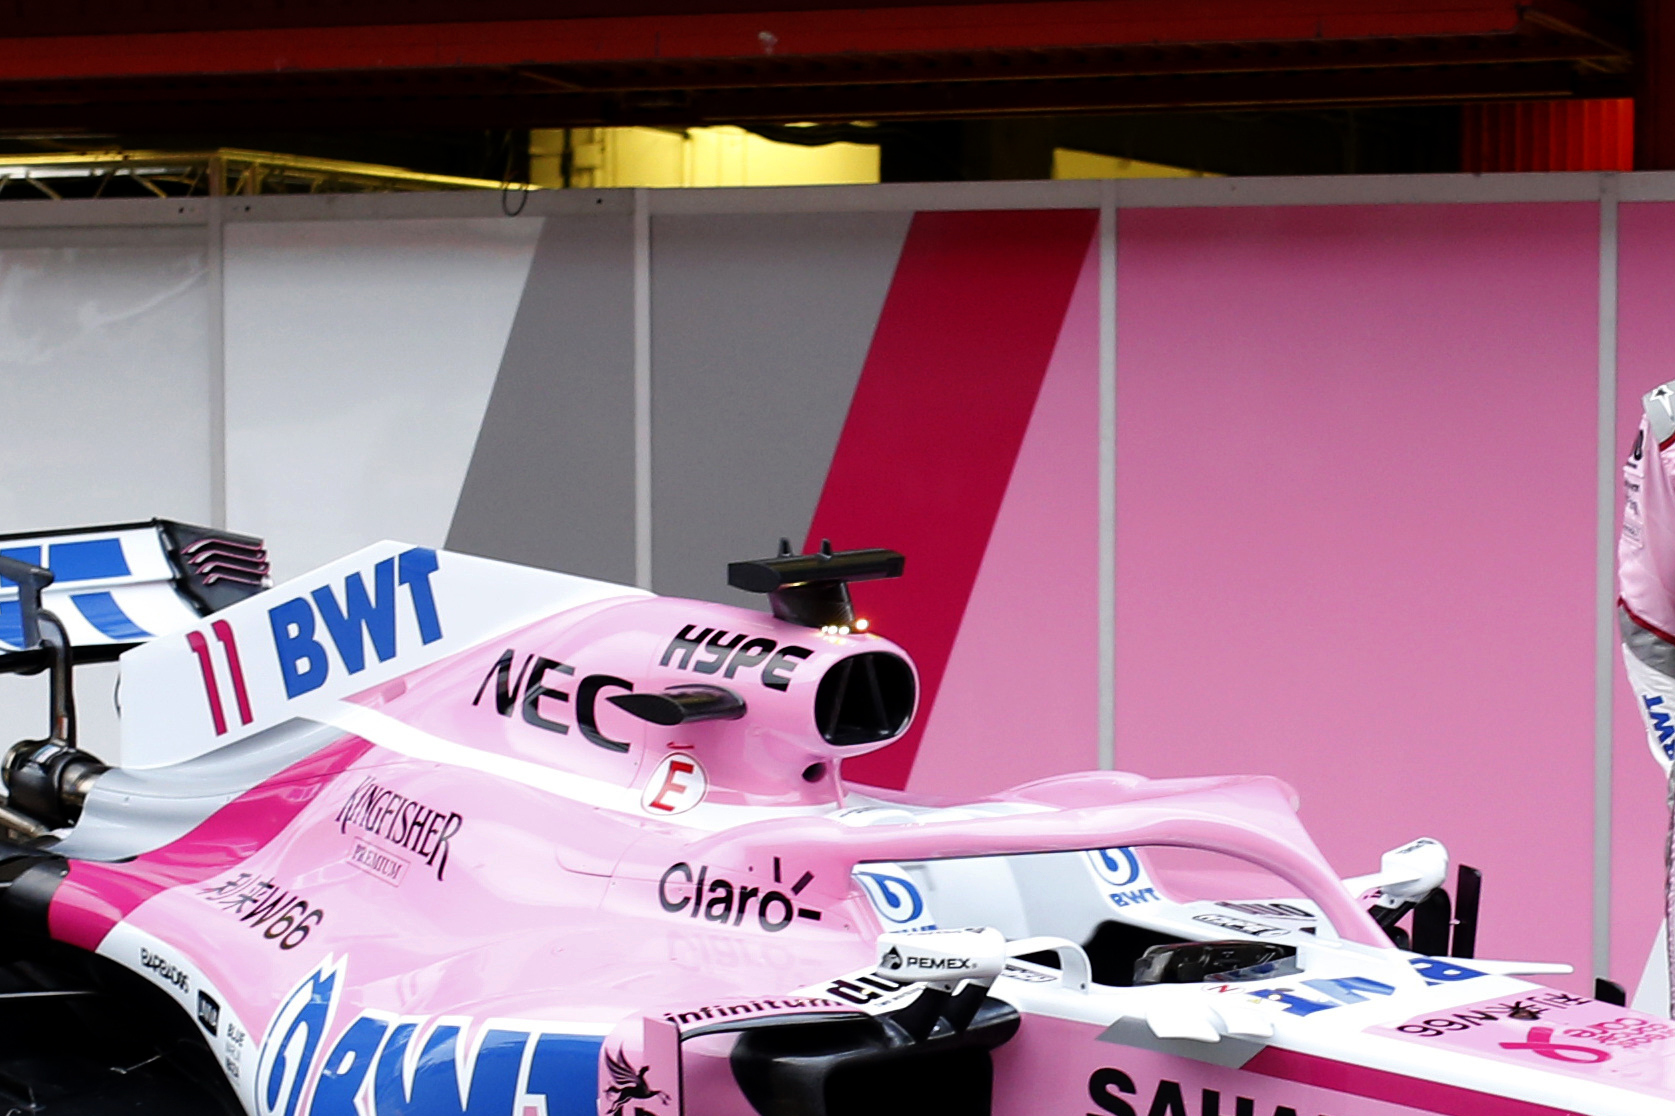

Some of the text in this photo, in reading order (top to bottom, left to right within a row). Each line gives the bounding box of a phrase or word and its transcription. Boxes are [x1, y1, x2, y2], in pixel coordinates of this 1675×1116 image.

[268, 547, 443, 700] BWT
[660, 624, 815, 692] HYPE
[187, 618, 253, 737] 11
[473, 648, 634, 754] NEC
[648, 760, 694, 811] E
[335, 775, 463, 882] KINGFISHER
[352, 843, 403, 880] PREMIUM
[659, 861, 795, 932] Claro
[1109, 888, 1160, 907] BWT
[906, 956, 971, 970] PEMEX
